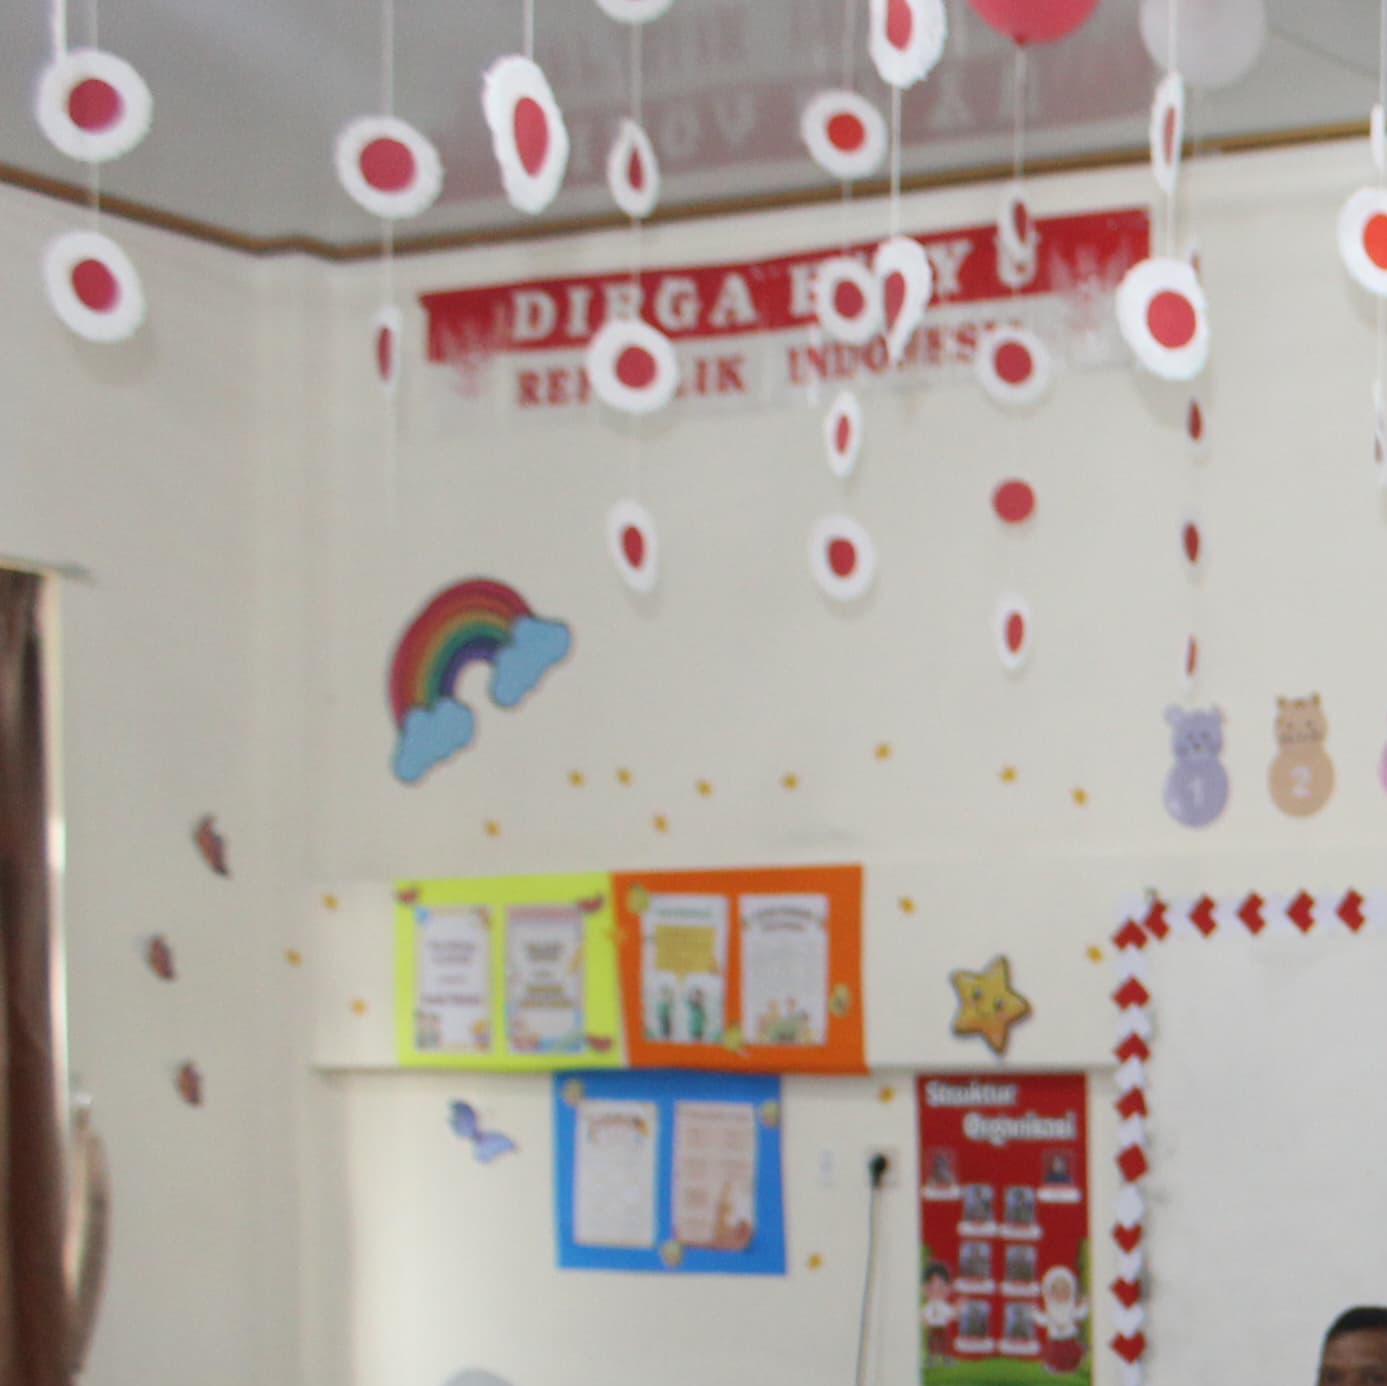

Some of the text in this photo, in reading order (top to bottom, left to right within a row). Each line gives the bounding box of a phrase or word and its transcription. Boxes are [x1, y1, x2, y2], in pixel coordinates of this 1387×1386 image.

[1291, 766, 1313, 799] 2
[924, 1079, 1020, 1108] Struktur
[962, 1110, 1077, 1147] Organisasi
